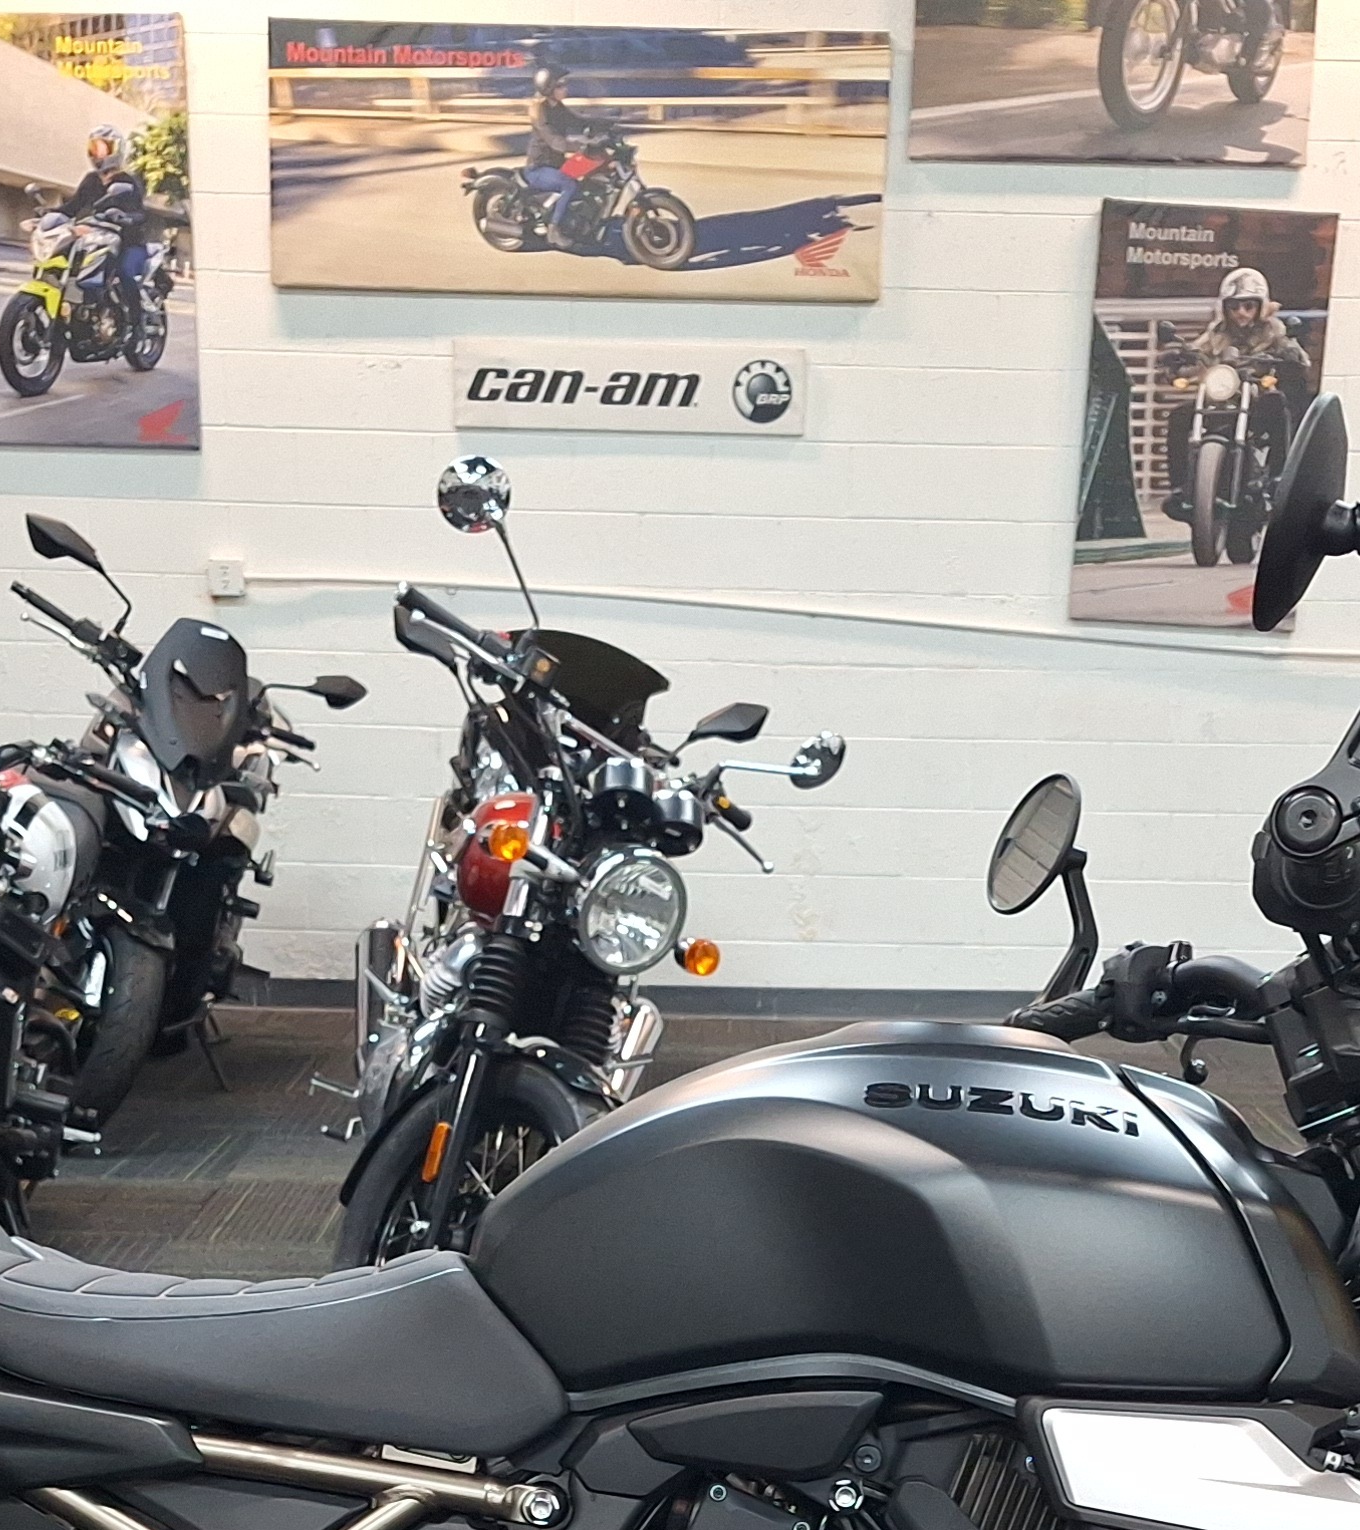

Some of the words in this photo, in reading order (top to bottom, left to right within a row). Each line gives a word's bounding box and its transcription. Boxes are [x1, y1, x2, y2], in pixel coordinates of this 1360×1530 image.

[286, 41, 386, 64] Mountain
[393, 44, 526, 67] Motorsports
[1128, 221, 1215, 242] Mountain
[1126, 246, 1239, 269] Motorsports
[794, 268, 850, 277] HONDA
[466, 367, 700, 407] can-am
[755, 392, 790, 406] BRP
[863, 1081, 1141, 1138] SUZUKI
